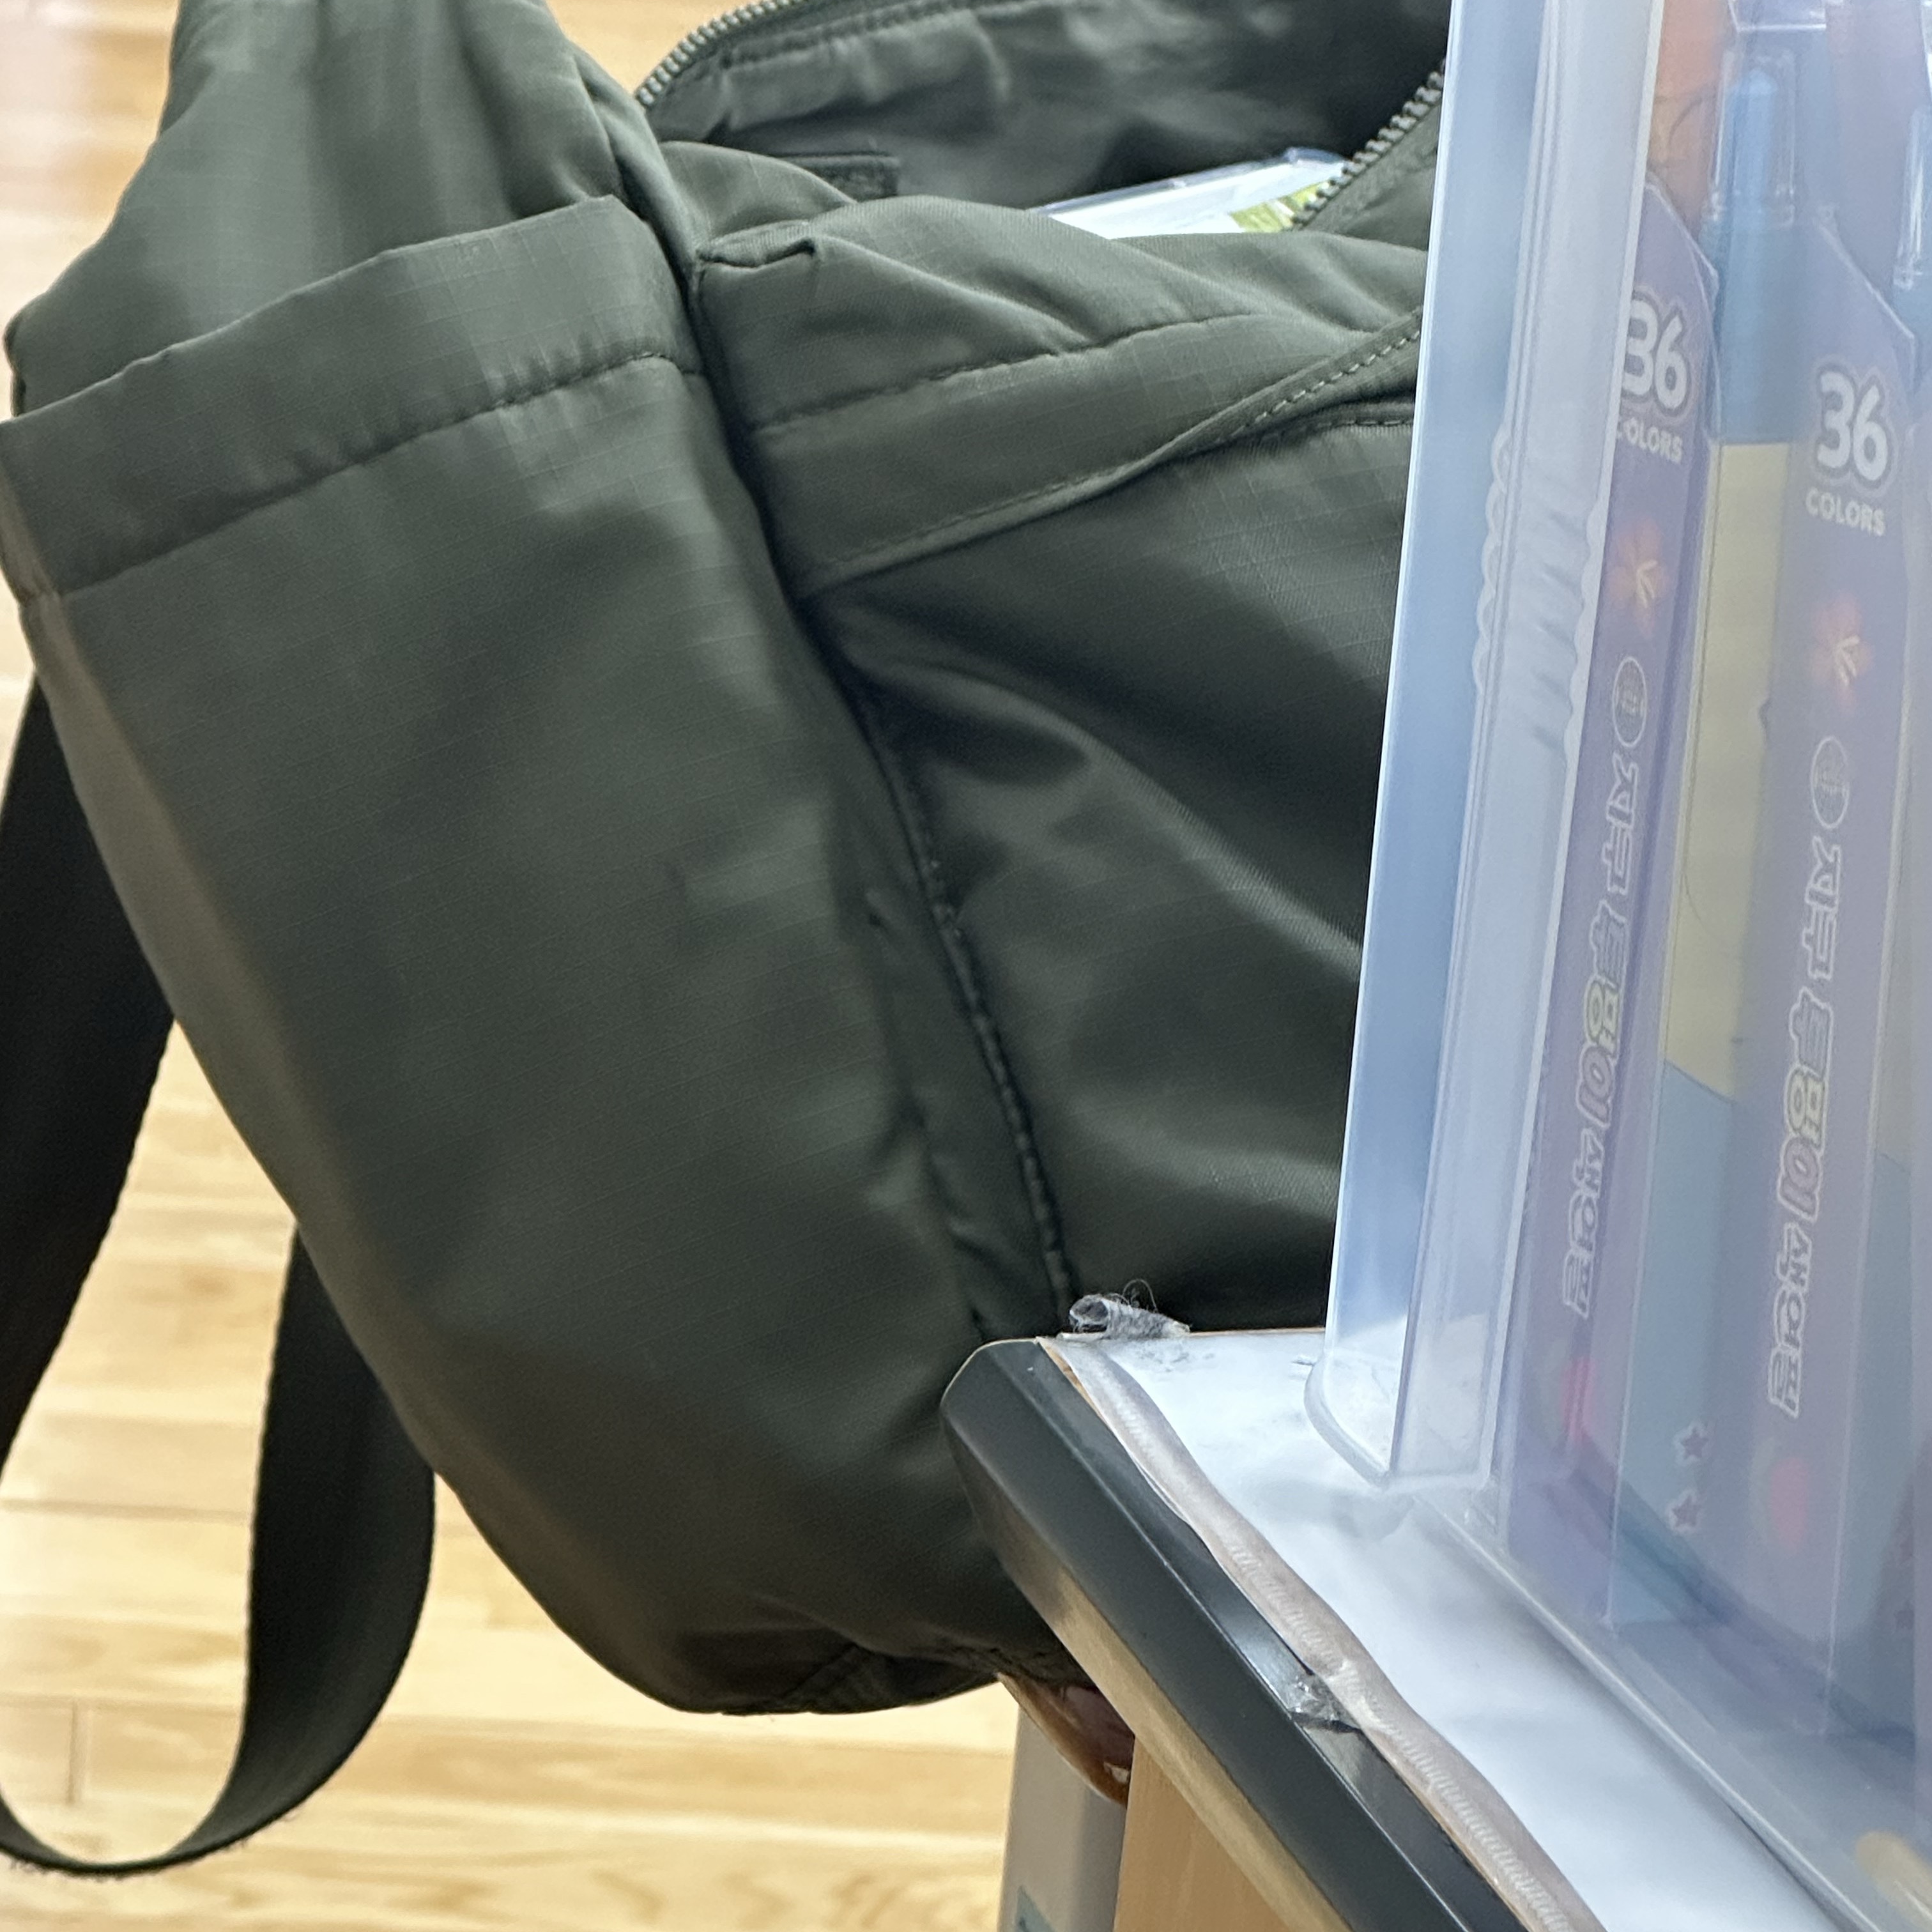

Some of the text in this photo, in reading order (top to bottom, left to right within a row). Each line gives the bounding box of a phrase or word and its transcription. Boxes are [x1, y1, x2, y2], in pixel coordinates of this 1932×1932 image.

[1620, 297, 1688, 410] 36
[1616, 417, 1683, 464] OLORS
[1816, 370, 1889, 481] 36
[1805, 487, 1887, 537] COLORS
[1602, 751, 1638, 894] 지구
[1802, 835, 1841, 980] 지구
[1563, 1128, 1606, 1320] 색연필
[1768, 1222, 1813, 1419] 색연필
